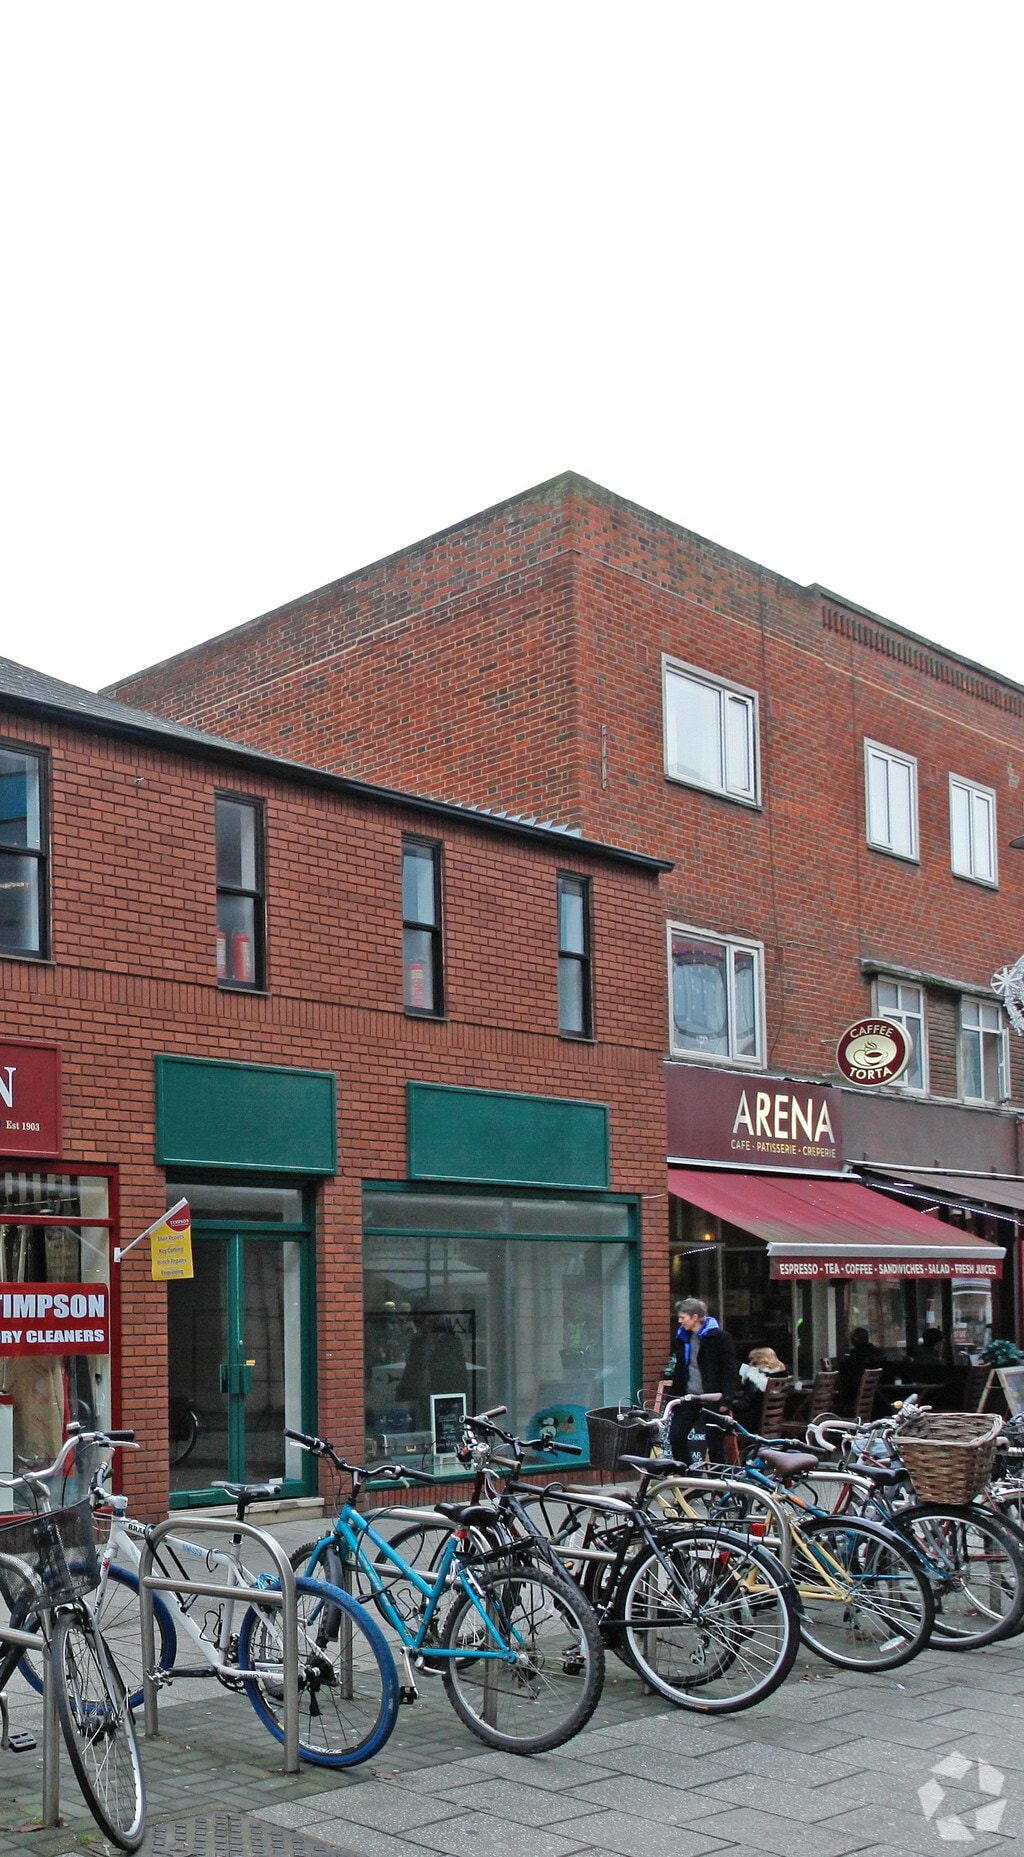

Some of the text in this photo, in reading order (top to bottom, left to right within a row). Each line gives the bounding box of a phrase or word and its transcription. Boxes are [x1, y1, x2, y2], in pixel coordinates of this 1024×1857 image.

[849, 1024, 894, 1038] CAFFEE
[849, 1066, 893, 1080] TORTA
[732, 1089, 836, 1143] ARENA
[6, 1120, 20, 1130] Est
[22, 1122, 40, 1132] 1903
[730, 1139, 751, 1151] CAFE
[756, 1141, 797, 1155] PATISSERIE
[802, 1146, 836, 1158] CREPERIE
[779, 1263, 818, 1275] ESPRESSO
[825, 1264, 839, 1274] TEA
[845, 1264, 873, 1274] COFFEE
[878, 1264, 924, 1275] SANDWICHES
[928, 1264, 950, 1274] SALAD
[955, 1264, 974, 1274] FRESH
[975, 1264, 996, 1275] JUICES
[26, 1329, 105, 1343] CLEANERS
